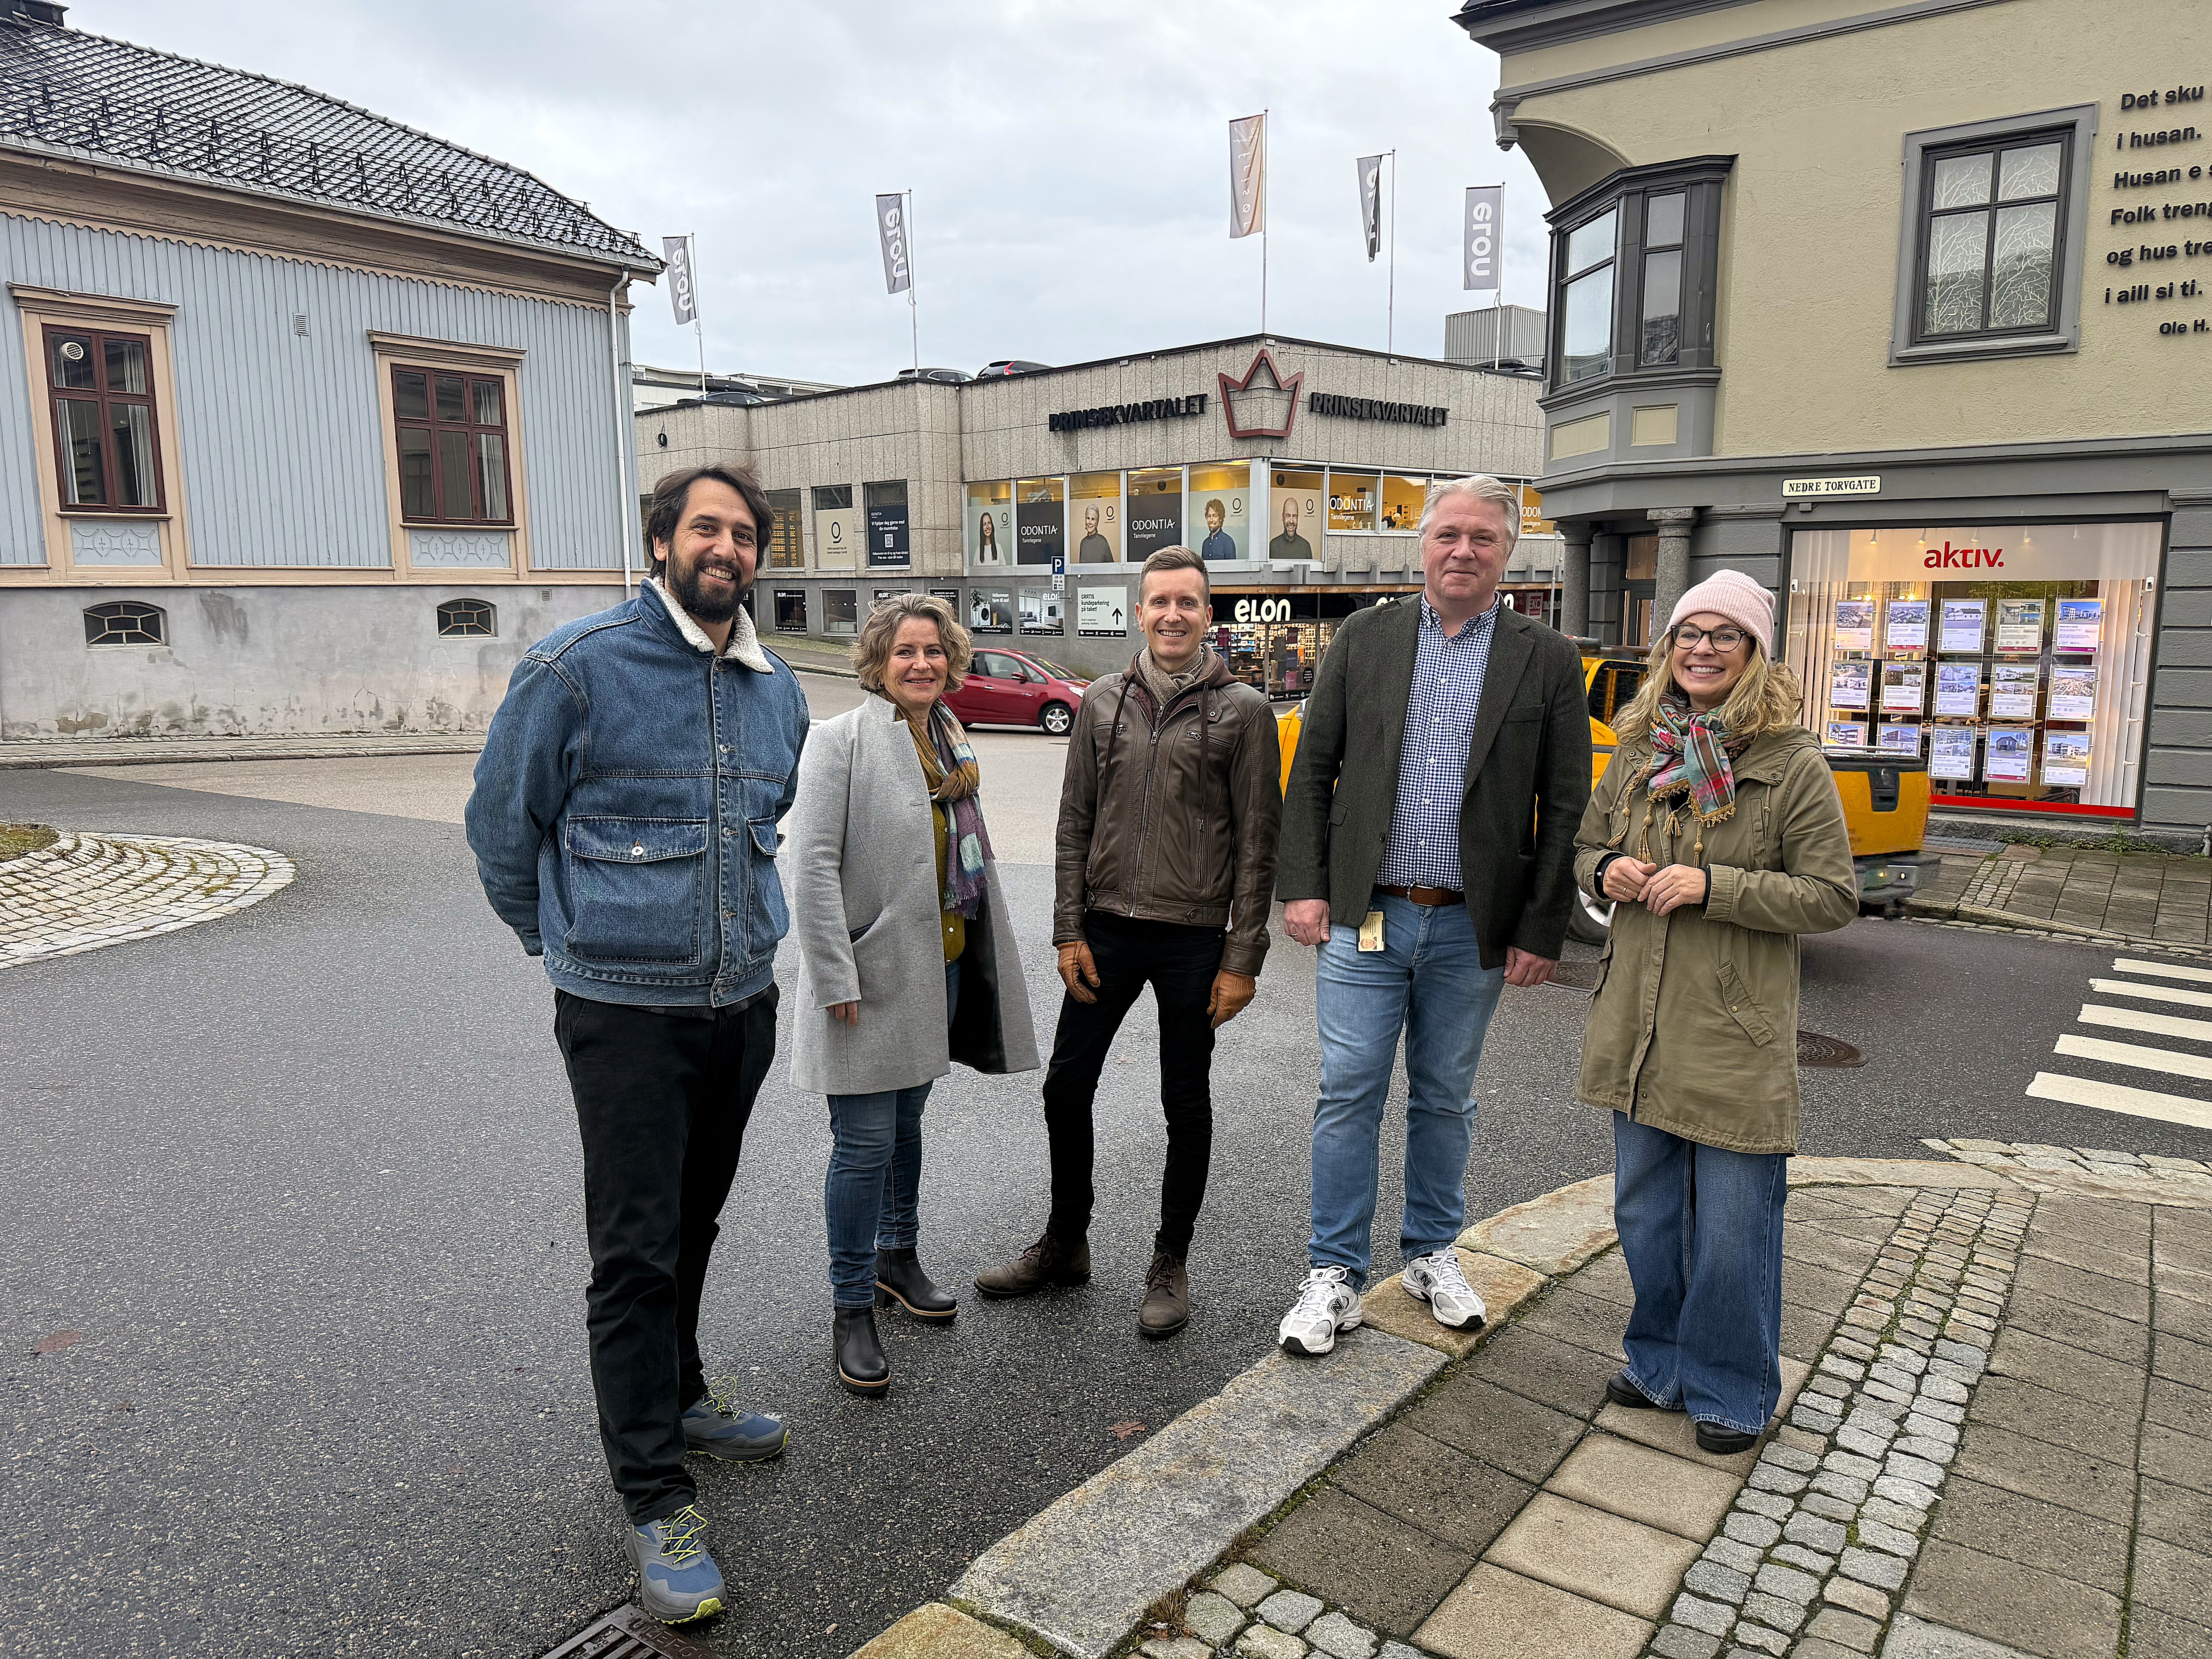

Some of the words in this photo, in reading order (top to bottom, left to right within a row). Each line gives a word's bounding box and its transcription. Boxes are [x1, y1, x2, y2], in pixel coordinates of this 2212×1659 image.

[2121, 90, 2158, 110] Det
[2165, 86, 2204, 103] sku
[2130, 127, 2202, 147] husan.
[2114, 168, 2181, 188] Husan
[2189, 166, 2201, 178] e
[2111, 205, 2157, 225] Folk
[2107, 248, 2134, 266] og
[2140, 245, 2178, 260] hus
[2105, 288, 2111, 303] i
[2117, 285, 2149, 302] aill
[2155, 282, 2173, 298] si
[2180, 279, 2203, 296] ti.
[2159, 321, 2188, 334] Ole
[2193, 319, 2210, 332] H.
[1049, 393, 1208, 432] PRINSEKVARTALET
[1309, 392, 1449, 426] PRINSEKVARTALET
[1789, 482, 1821, 492] NEDRE
[1825, 480, 1876, 491] TORVGATE
[1329, 497, 1374, 511] ODONTIA
[1021, 525, 1058, 535] ODONTIA
[1132, 519, 1175, 530] ODONTIA
[1055, 559, 1062, 572] P
